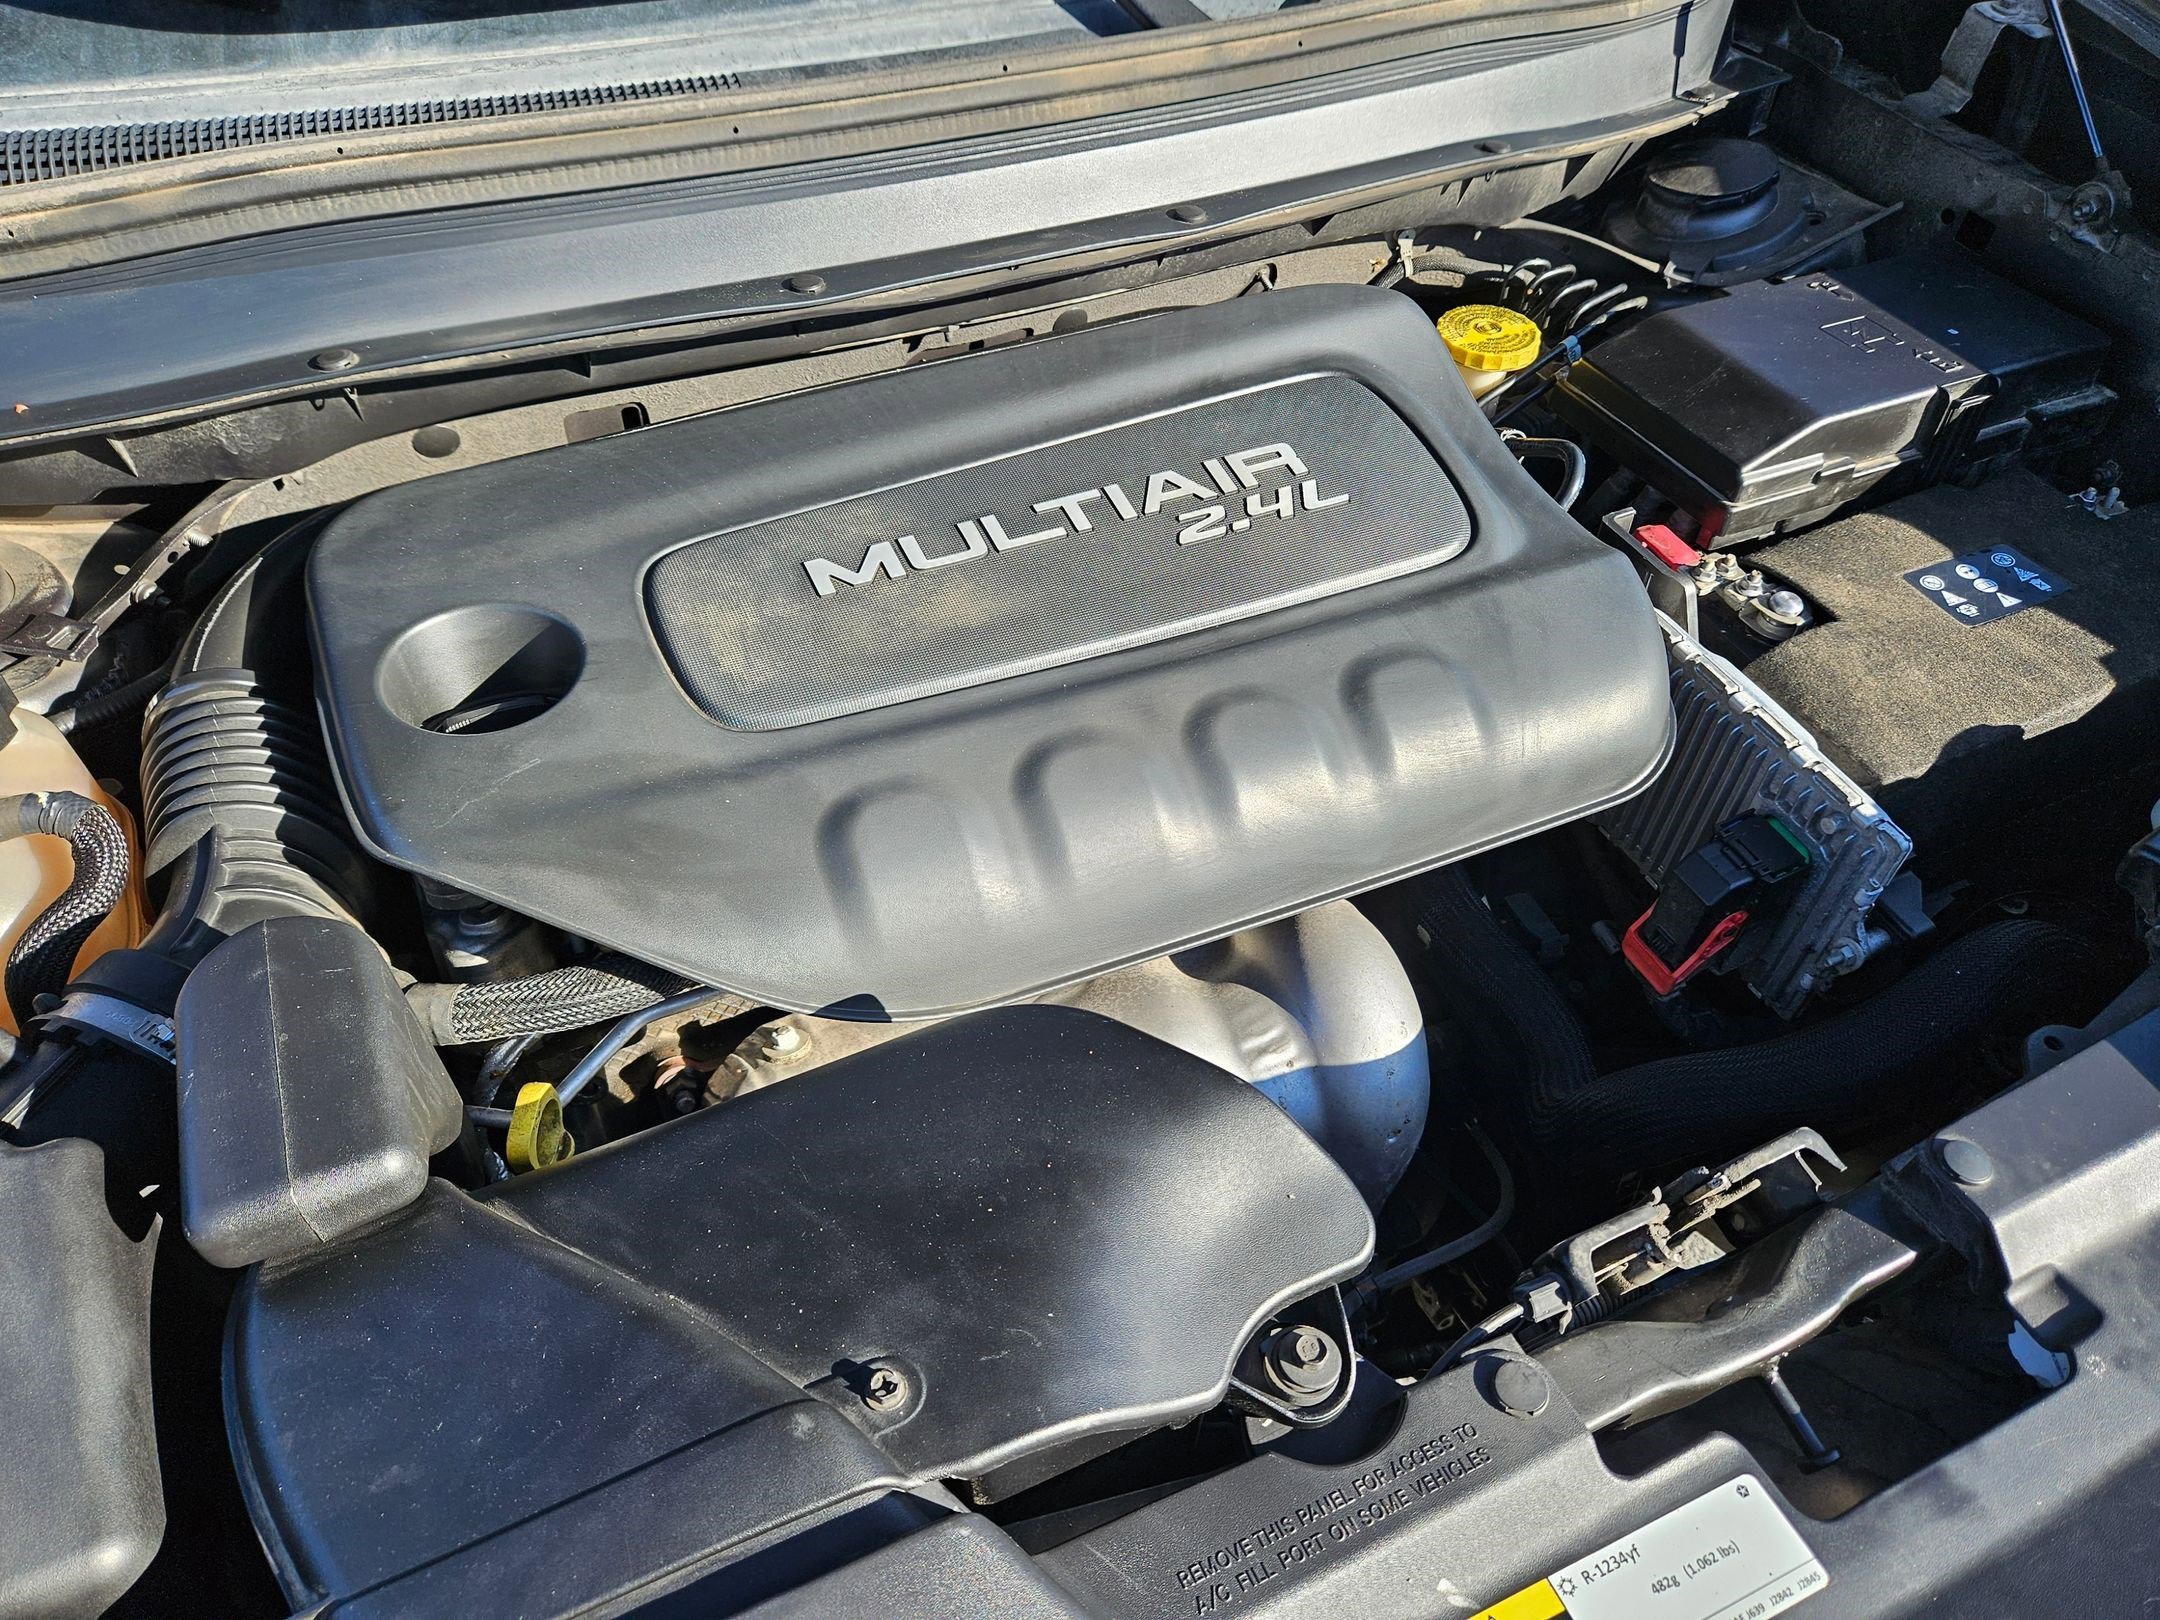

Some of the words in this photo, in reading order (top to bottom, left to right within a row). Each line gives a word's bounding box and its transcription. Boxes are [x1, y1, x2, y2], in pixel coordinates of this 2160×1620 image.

[801, 440, 1310, 597] MULTIAIR
[1175, 478, 1350, 546] 2.4L
[1176, 1537, 1256, 1590] REMOVE
[1251, 1516, 1297, 1549] THIS
[1295, 1488, 1356, 1527] PANEL
[1351, 1468, 1392, 1498] FOR
[1390, 1434, 1456, 1479] ACCESS
[1451, 1422, 1478, 1444] TO
[1195, 1584, 1233, 1616] A/C
[1235, 1561, 1279, 1593] FILL
[1277, 1532, 1327, 1570] PORT
[1328, 1515, 1360, 1542] ON
[1357, 1488, 1413, 1528] SOME
[1408, 1446, 1493, 1498] VEHICLES
[1580, 1543, 1641, 1585] R-1234yf
[1651, 1574, 1681, 1595] 482g
[1682, 1551, 1719, 1580] (1.062
[1718, 1539, 1741, 1562] lbs)
